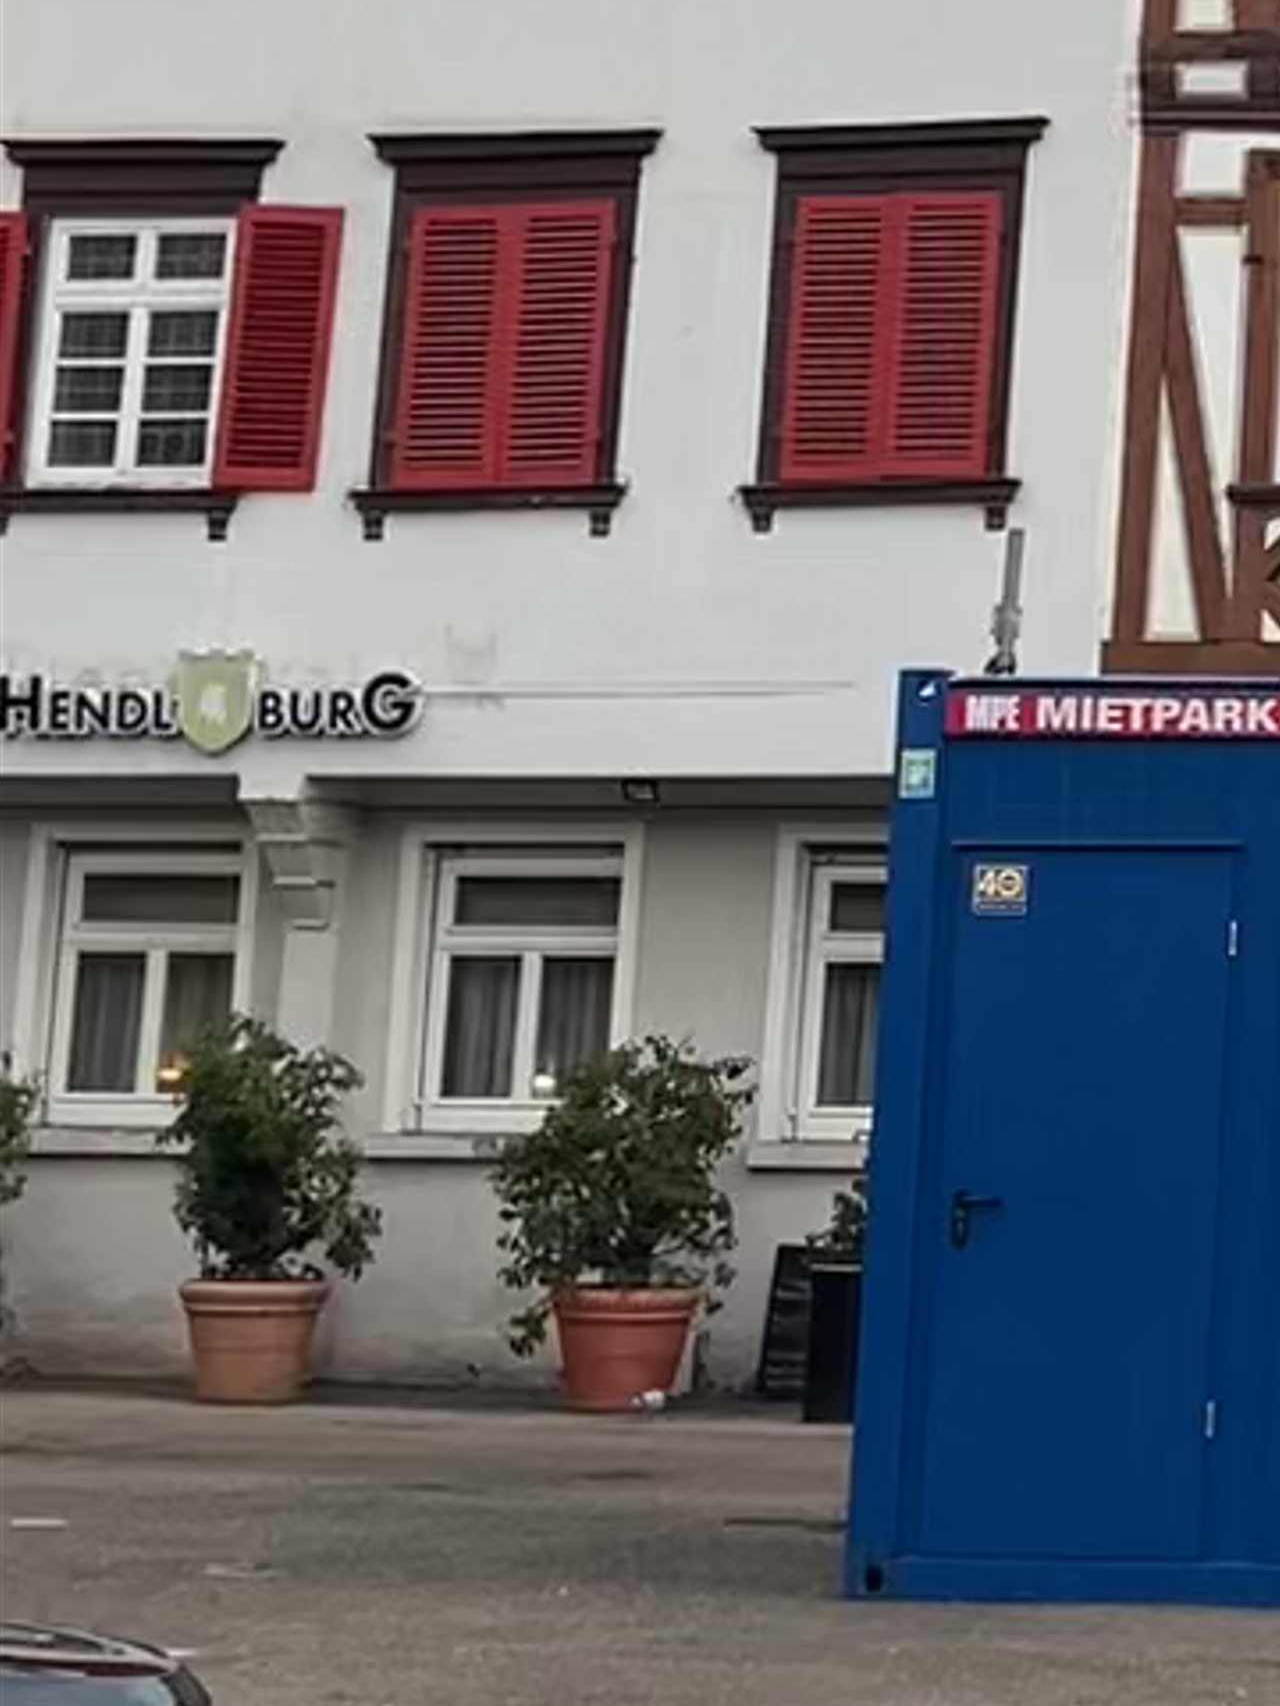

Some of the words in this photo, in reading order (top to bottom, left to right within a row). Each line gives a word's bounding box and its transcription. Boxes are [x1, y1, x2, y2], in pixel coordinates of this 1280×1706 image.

[0, 674, 177, 732] HENDL
[257, 672, 416, 732] BURG
[964, 695, 1020, 732] MPE
[1036, 696, 1280, 733] MIETPARK
